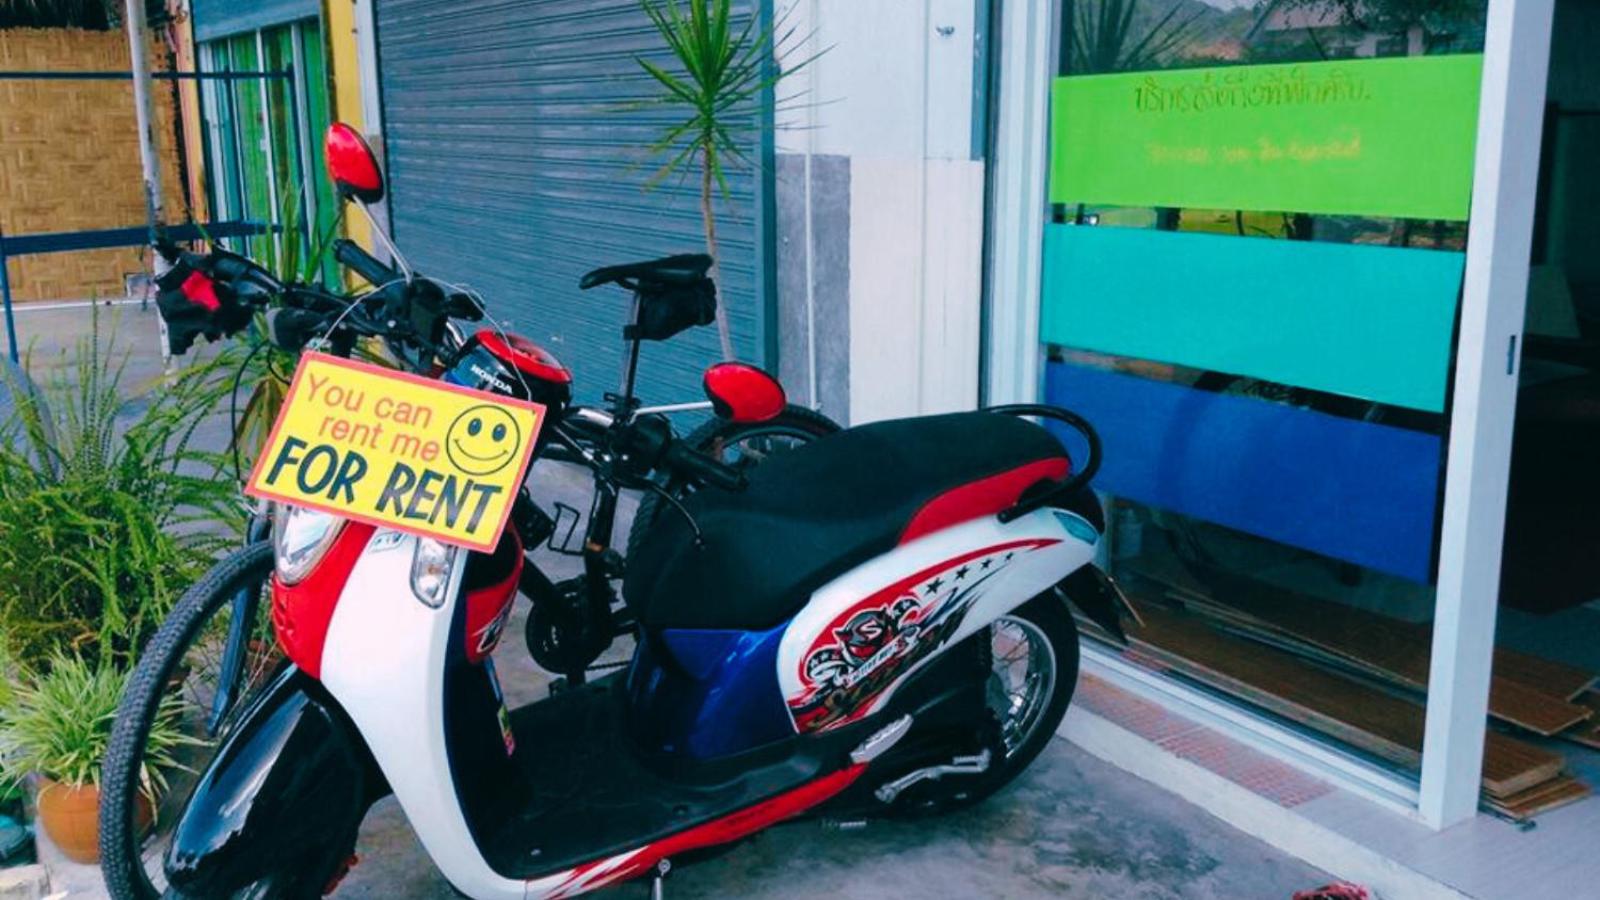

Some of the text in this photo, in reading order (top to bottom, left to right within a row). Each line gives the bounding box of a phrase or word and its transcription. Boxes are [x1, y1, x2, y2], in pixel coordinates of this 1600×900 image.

[307, 372, 433, 430] You can
[471, 363, 513, 394] HONDA
[317, 413, 441, 463] rent me
[266, 436, 502, 534] FOR RENT
